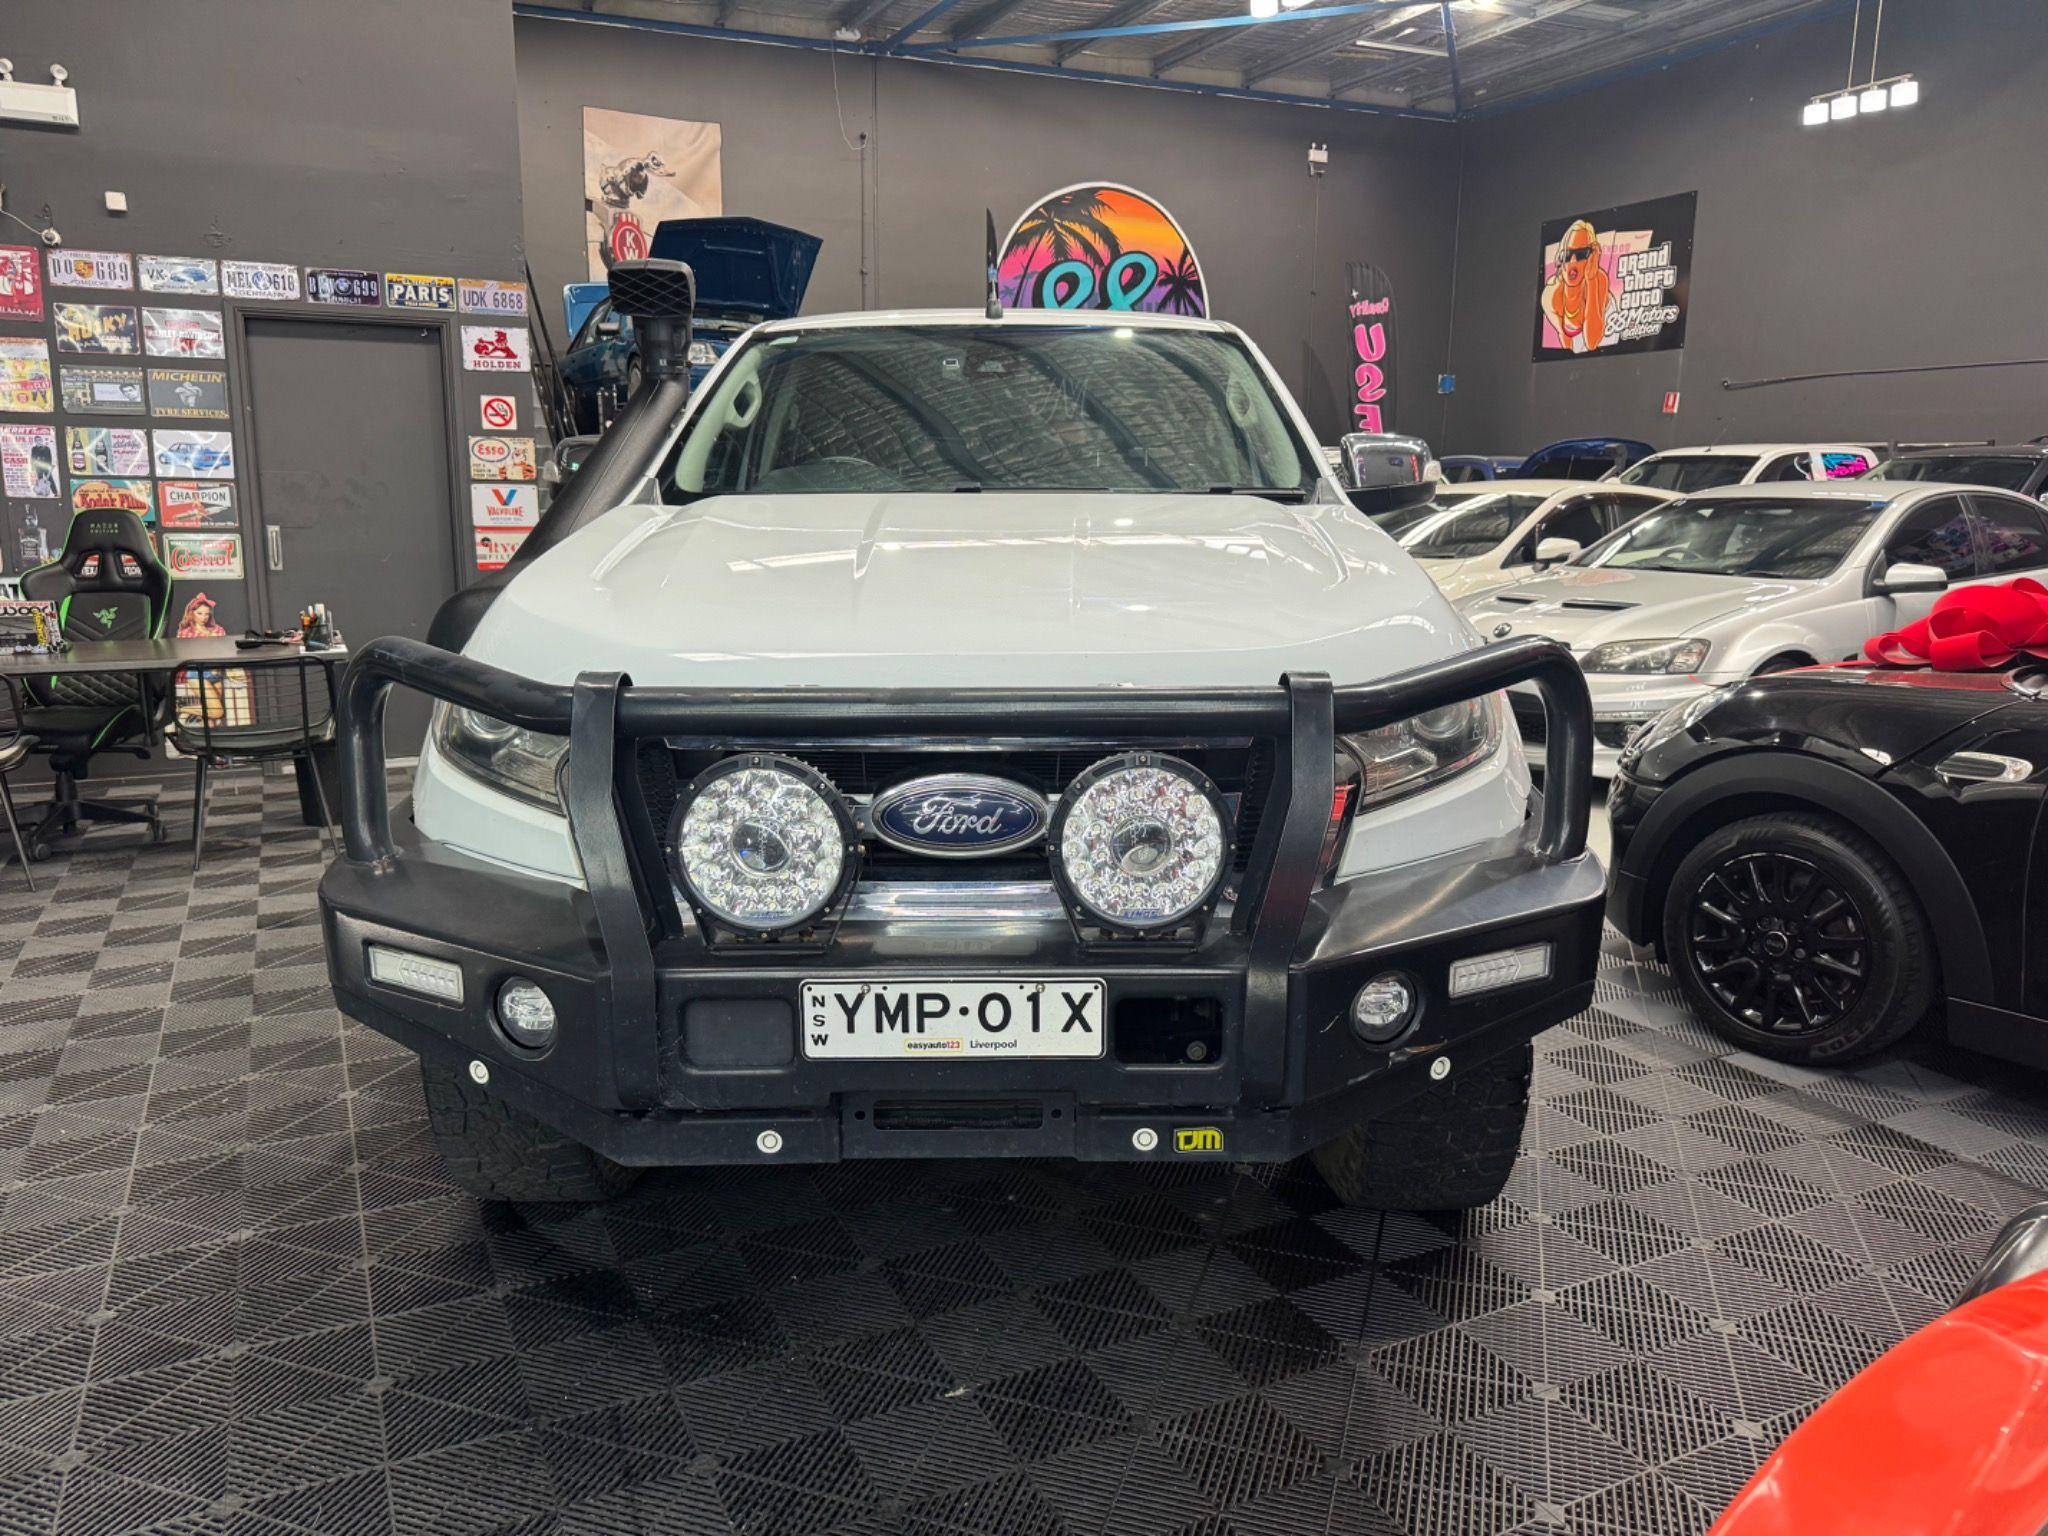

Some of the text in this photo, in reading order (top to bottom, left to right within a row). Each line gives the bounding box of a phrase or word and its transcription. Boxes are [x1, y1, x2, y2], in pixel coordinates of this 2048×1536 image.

[1618, 243, 1669, 278] grand
[95, 260, 129, 282] 689
[1624, 269, 1675, 293] theft
[393, 284, 450, 303] PARIS
[462, 289, 523, 310] UDK 6868
[1621, 287, 1661, 310] auto
[473, 359, 521, 369] HOLDEN
[152, 372, 223, 383] MICHELIN
[155, 407, 227, 418] TYRE SERVICES
[80, 493, 147, 509] Kodak Film
[169, 490, 227, 502] CHAMPION
[487, 505, 524, 517] VALVOLINE
[171, 542, 236, 572] Castrol
[913, 796, 1005, 836] Ford
[907, 1039, 1018, 1051] easyauto123 Liverpool
[1177, 1129, 1221, 1151] TJM
